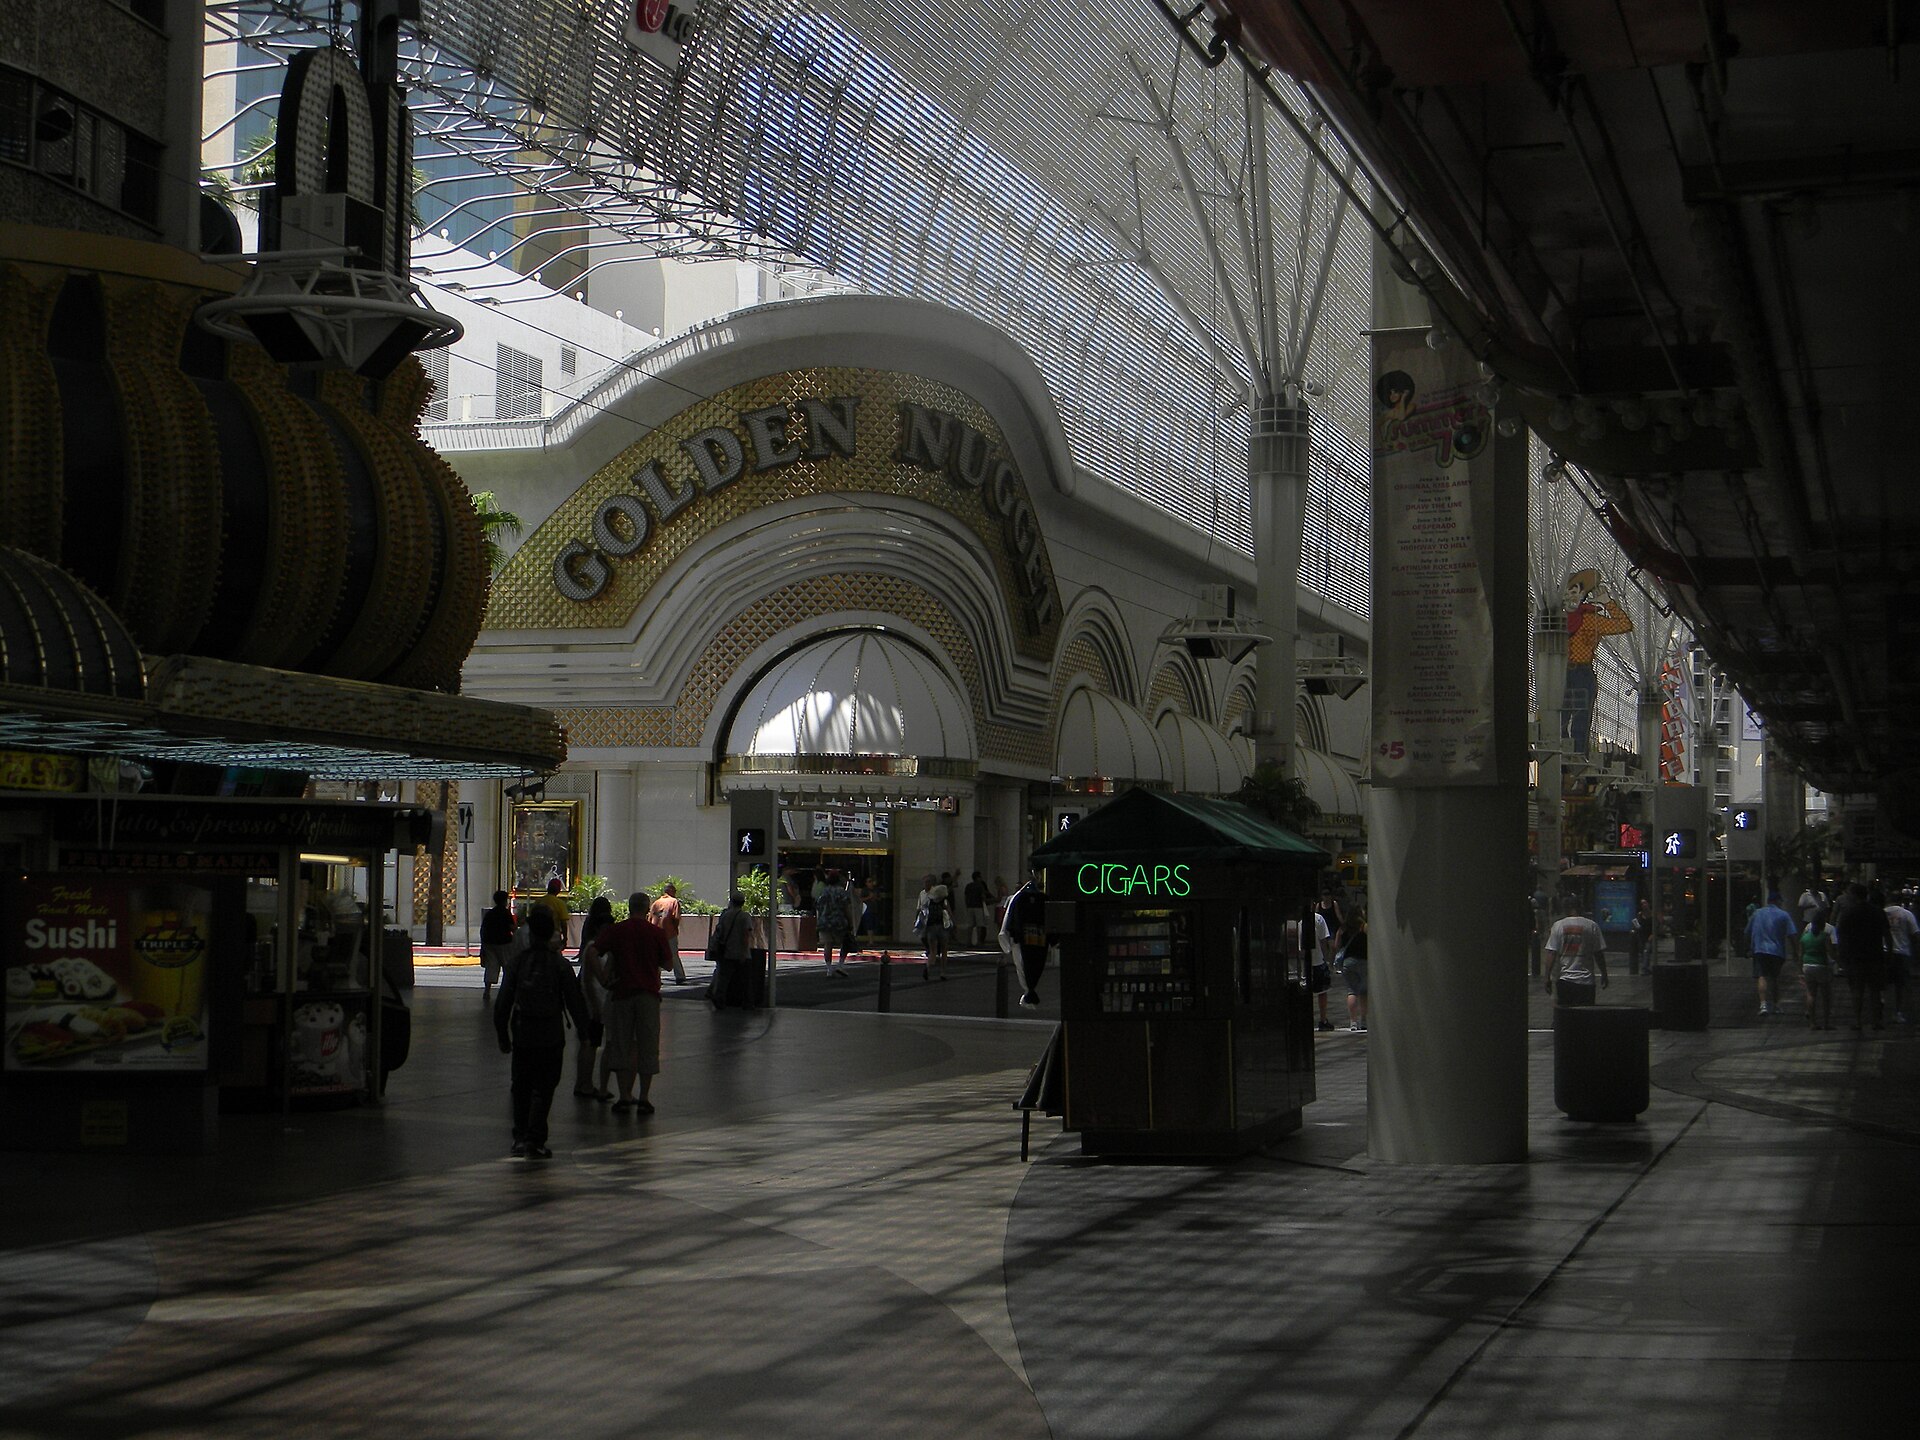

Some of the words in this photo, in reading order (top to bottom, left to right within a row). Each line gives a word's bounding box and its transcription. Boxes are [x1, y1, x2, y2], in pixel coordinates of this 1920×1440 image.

[552, 396, 860, 602] GOLDEN
[892, 401, 1053, 636] NUGGET
[1412, 522, 1456, 530] DESPERADO
[1379, 741, 1406, 760] $5
[169, 807, 279, 842] Espresso
[1077, 863, 1192, 897] CIGARS
[50, 885, 94, 902] Fresh
[73, 903, 110, 916] Made
[25, 918, 117, 950] Sushi
[140, 939, 188, 949] TRIPLE
